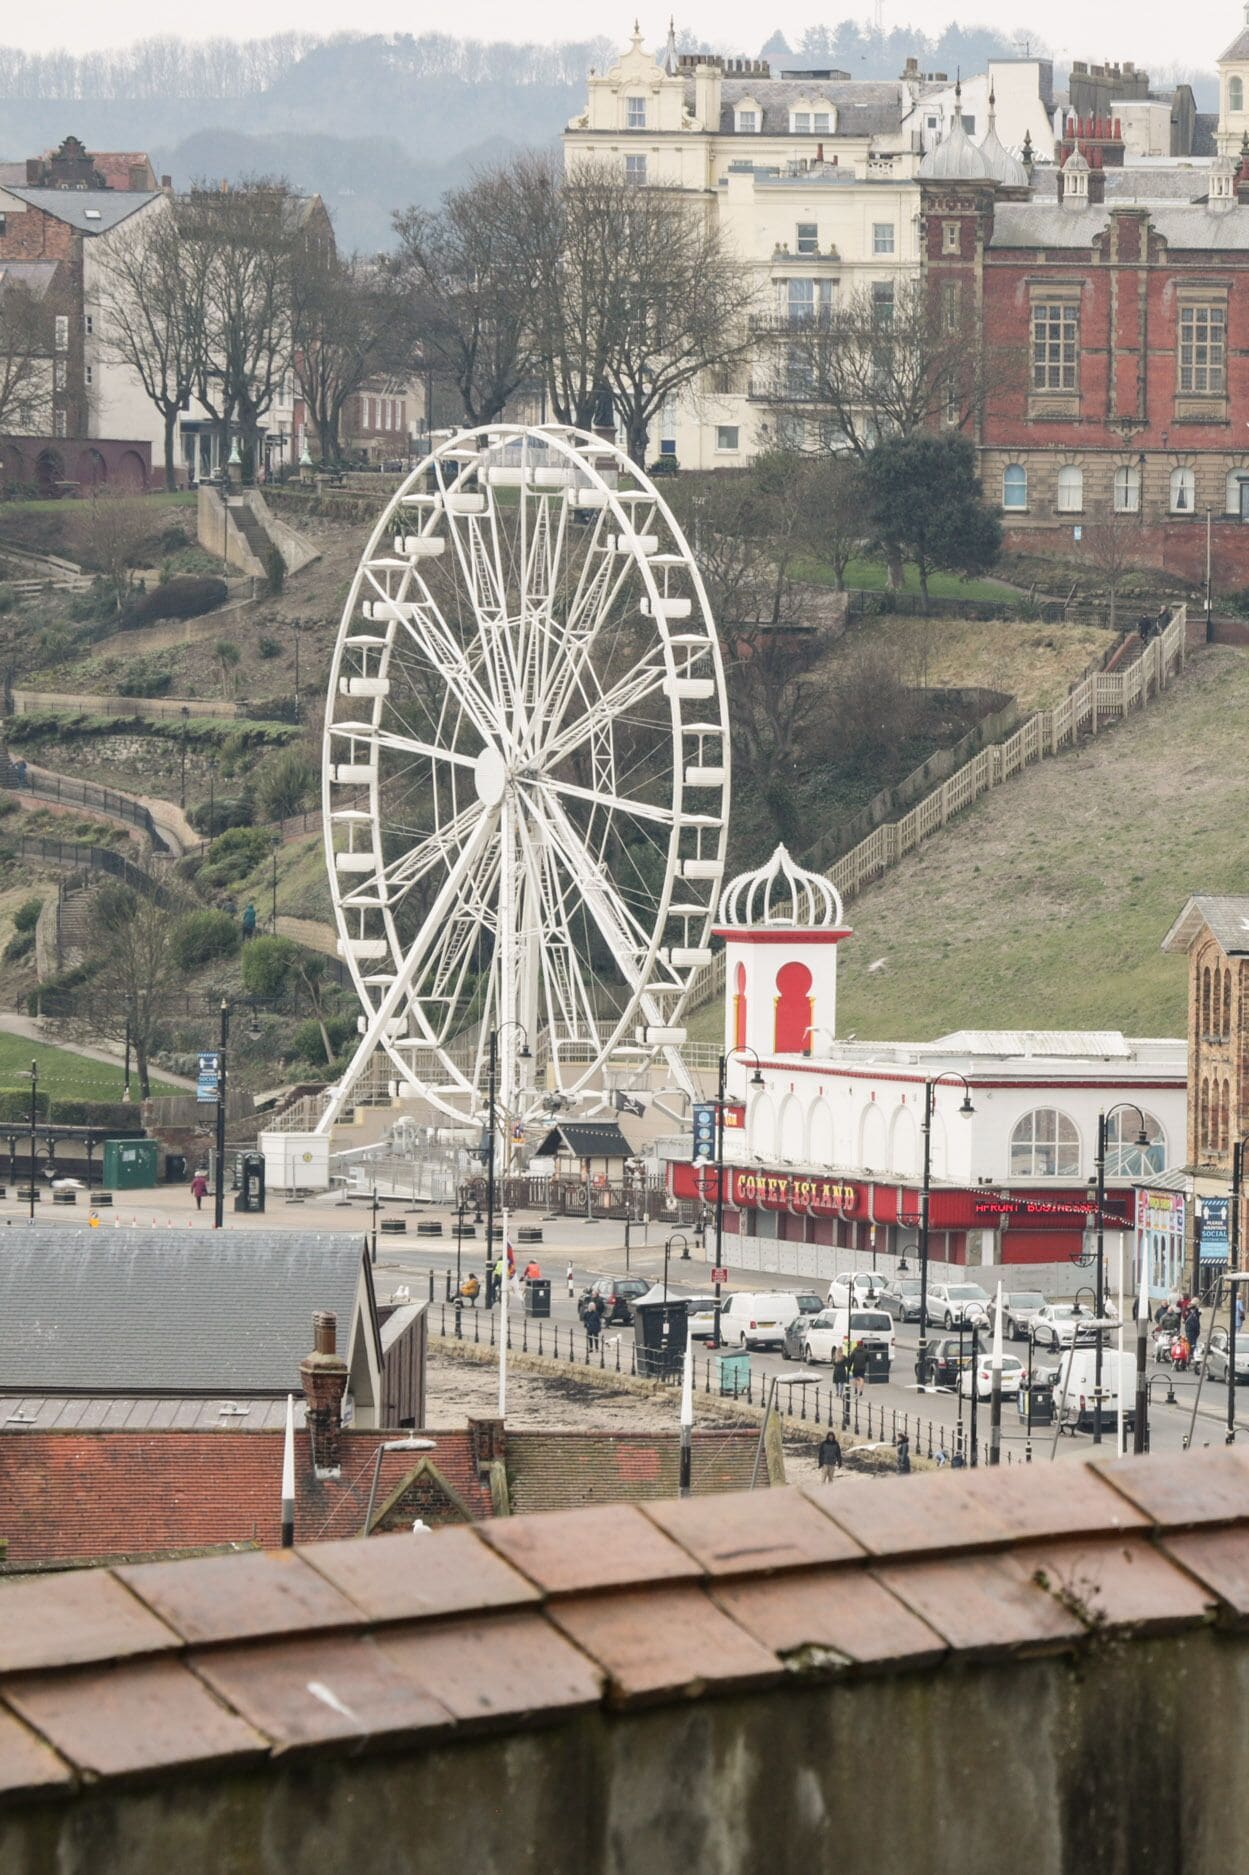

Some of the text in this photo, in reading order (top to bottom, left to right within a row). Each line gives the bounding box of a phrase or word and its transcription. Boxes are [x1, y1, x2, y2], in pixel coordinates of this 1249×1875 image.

[738, 1174, 855, 1210] CONEY ISLAND
[1201, 1230, 1228, 1238] SOCIAL
